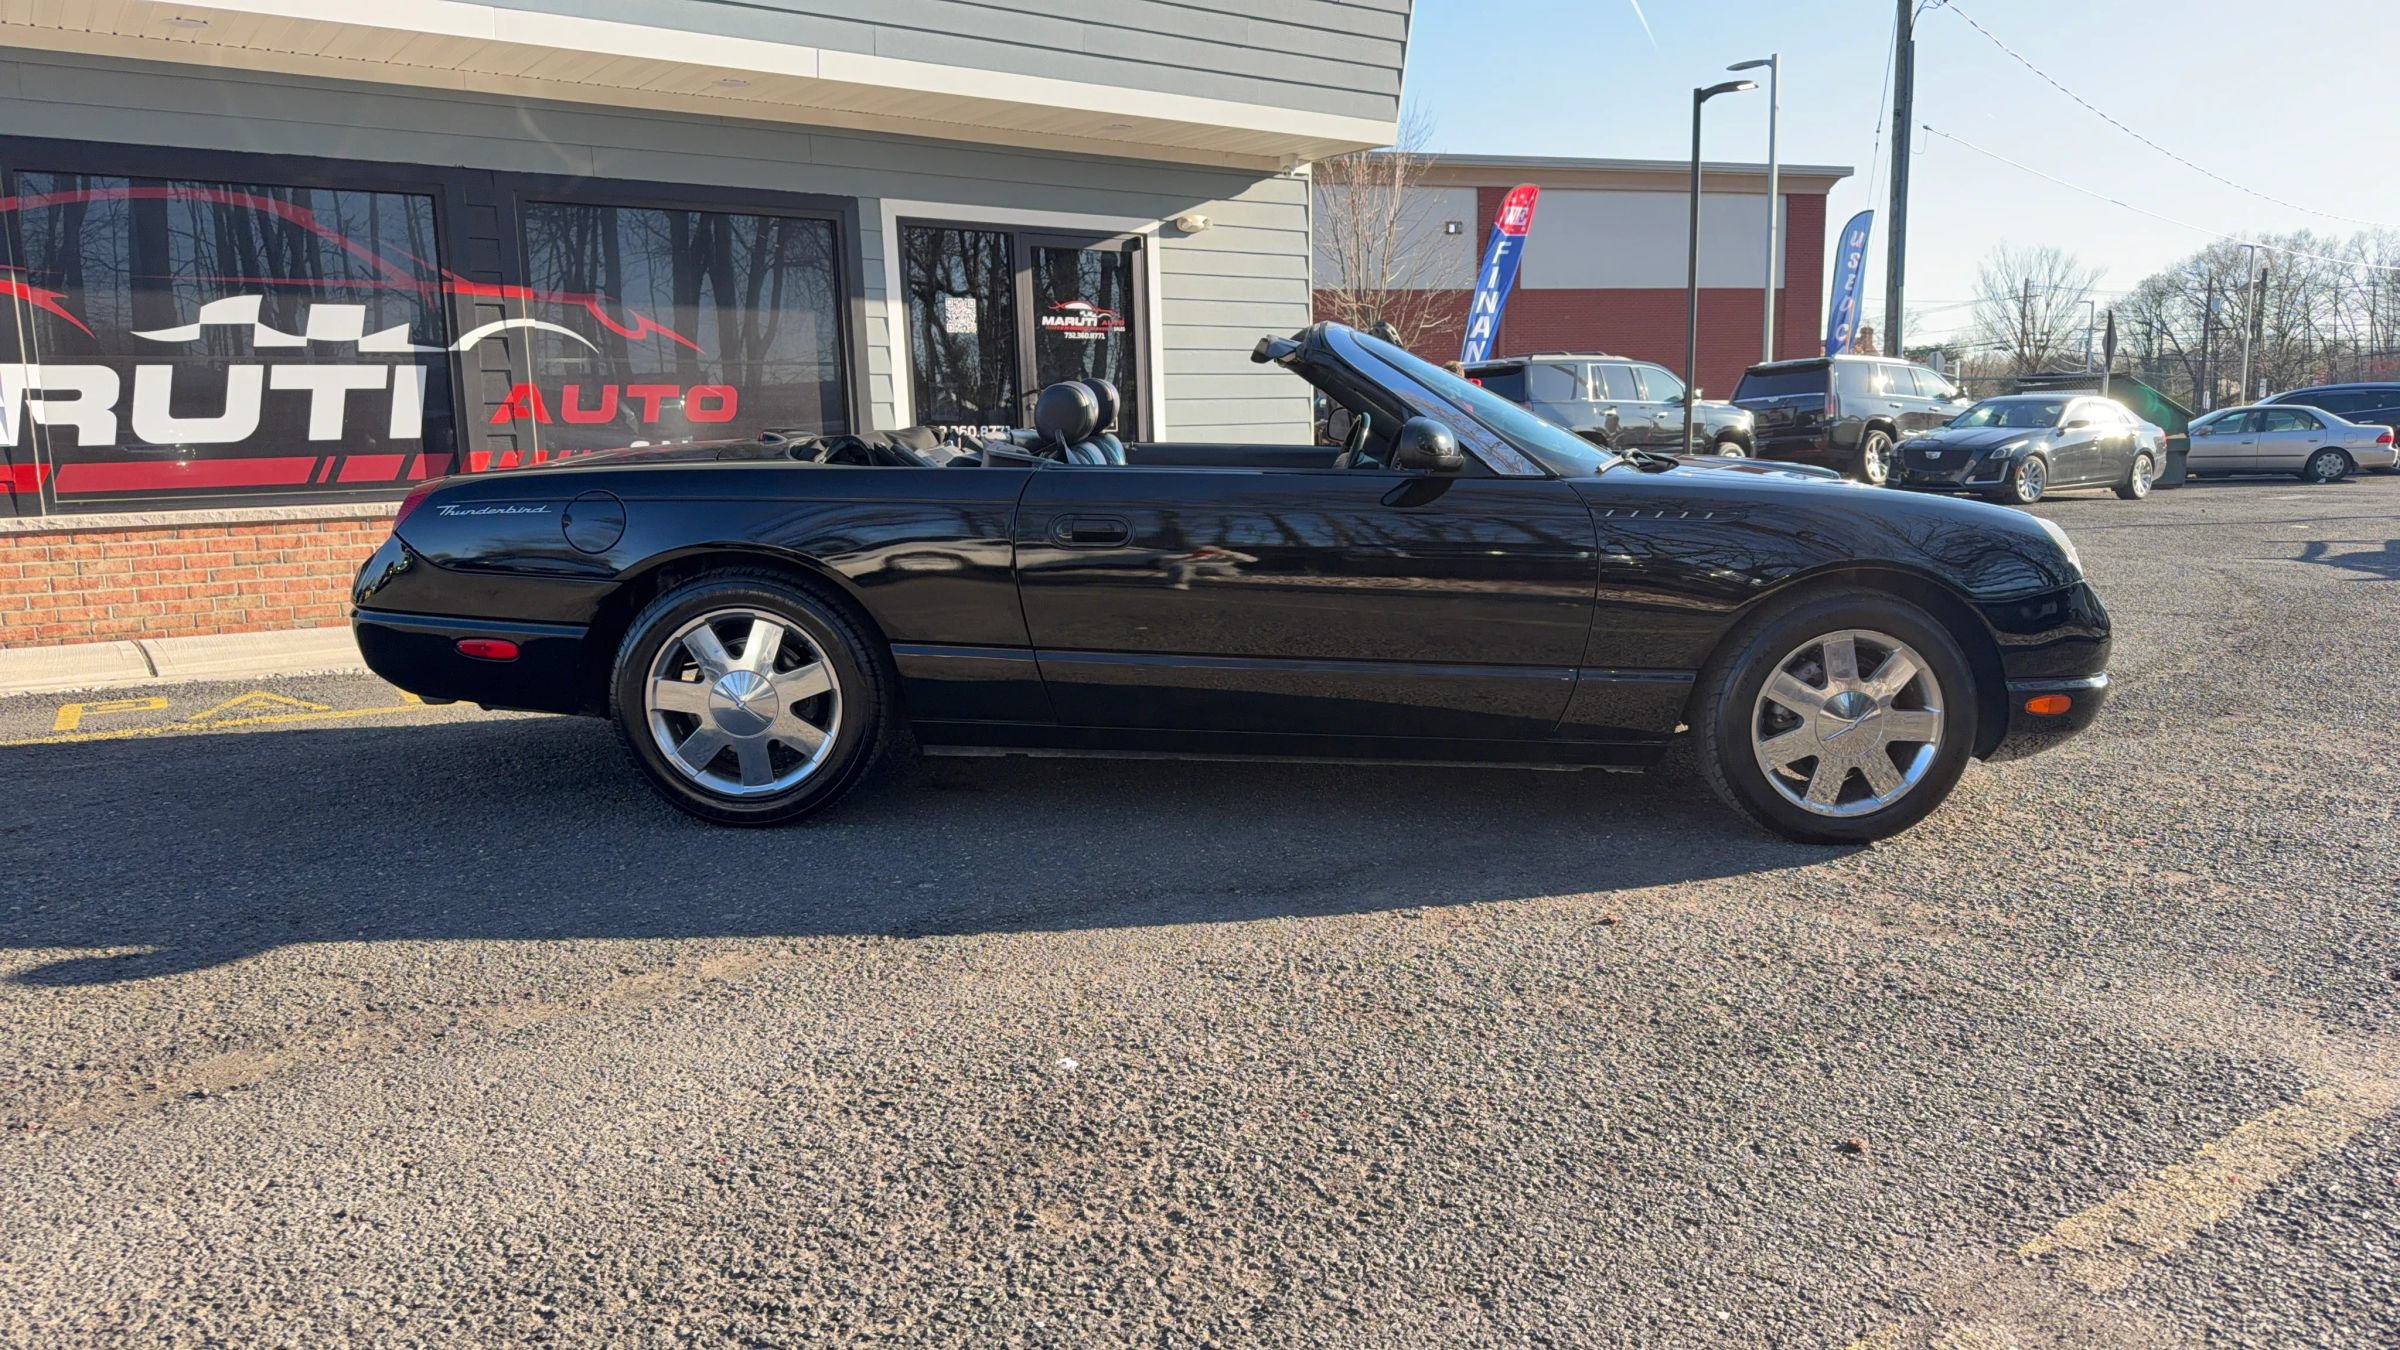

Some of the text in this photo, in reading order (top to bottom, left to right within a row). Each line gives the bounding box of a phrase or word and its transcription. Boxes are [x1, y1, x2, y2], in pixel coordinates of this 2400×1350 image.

[1504, 206, 1530, 226] WE
[1041, 316, 1126, 327] MARUTI AUTO
[488, 383, 739, 424] AUTO
[436, 504, 552, 516] Thunderbird
